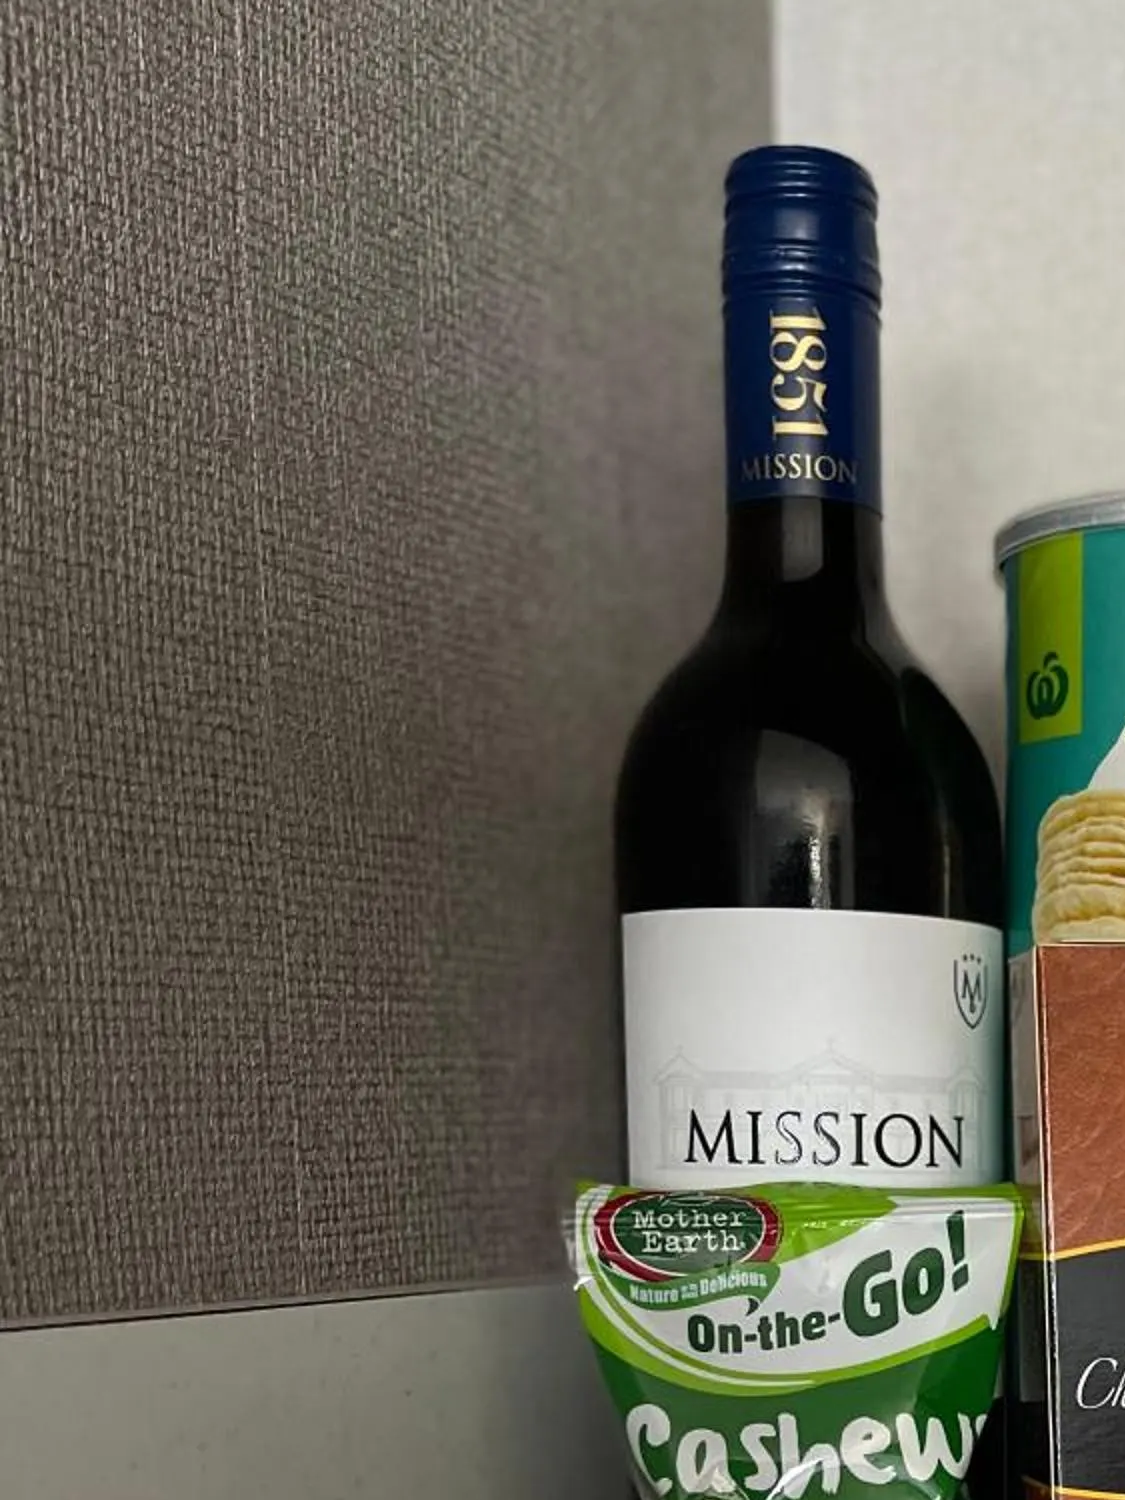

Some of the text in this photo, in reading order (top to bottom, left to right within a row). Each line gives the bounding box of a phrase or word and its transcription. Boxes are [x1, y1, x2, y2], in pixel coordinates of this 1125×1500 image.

[769, 307, 828, 440] 1851
[741, 453, 857, 483] MISSION
[684, 1108, 964, 1169] MISSION
[632, 1209, 746, 1229] Mother
[642, 1229, 741, 1253] Earth
[626, 1404, 988, 1499] Cashew
